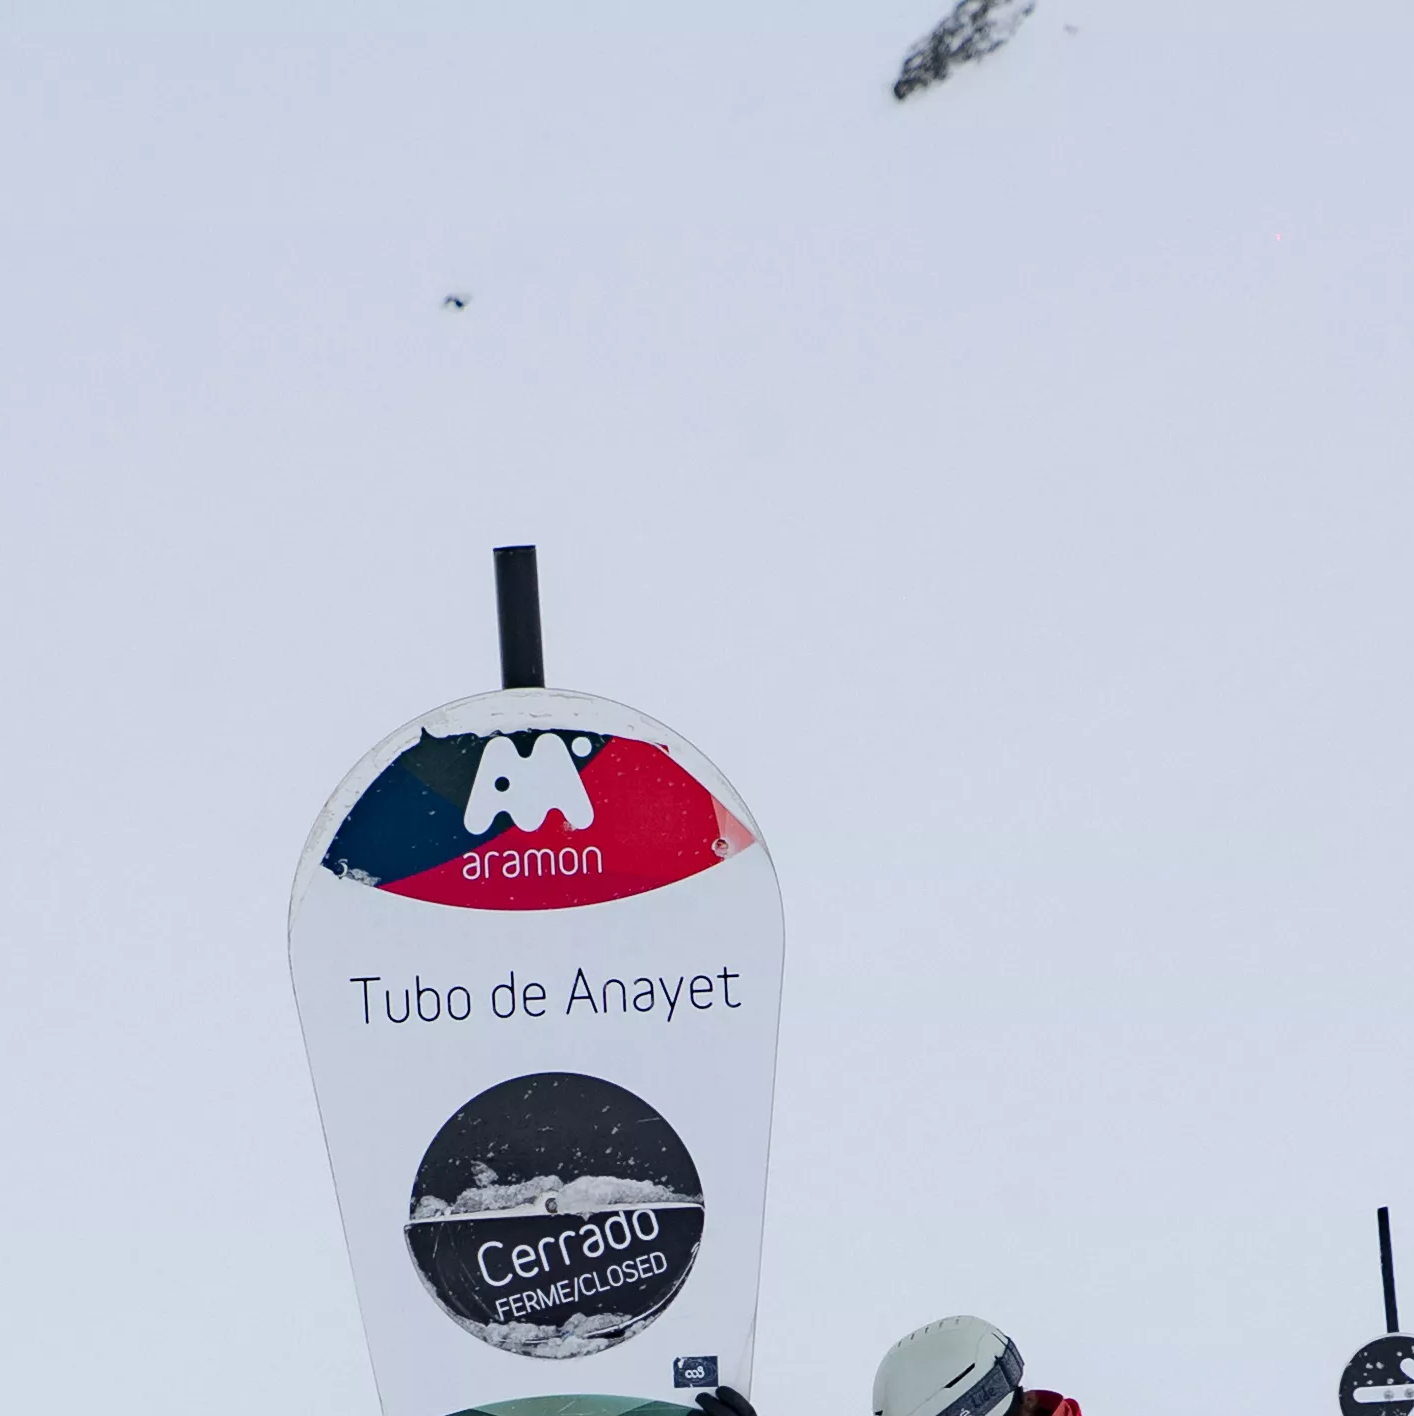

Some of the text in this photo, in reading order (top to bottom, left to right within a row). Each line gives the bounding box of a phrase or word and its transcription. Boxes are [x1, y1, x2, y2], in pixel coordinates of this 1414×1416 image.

[462, 845, 603, 880] aramon
[350, 966, 742, 1024] Tubo de Anayet
[477, 1209, 660, 1287] Cerrado
